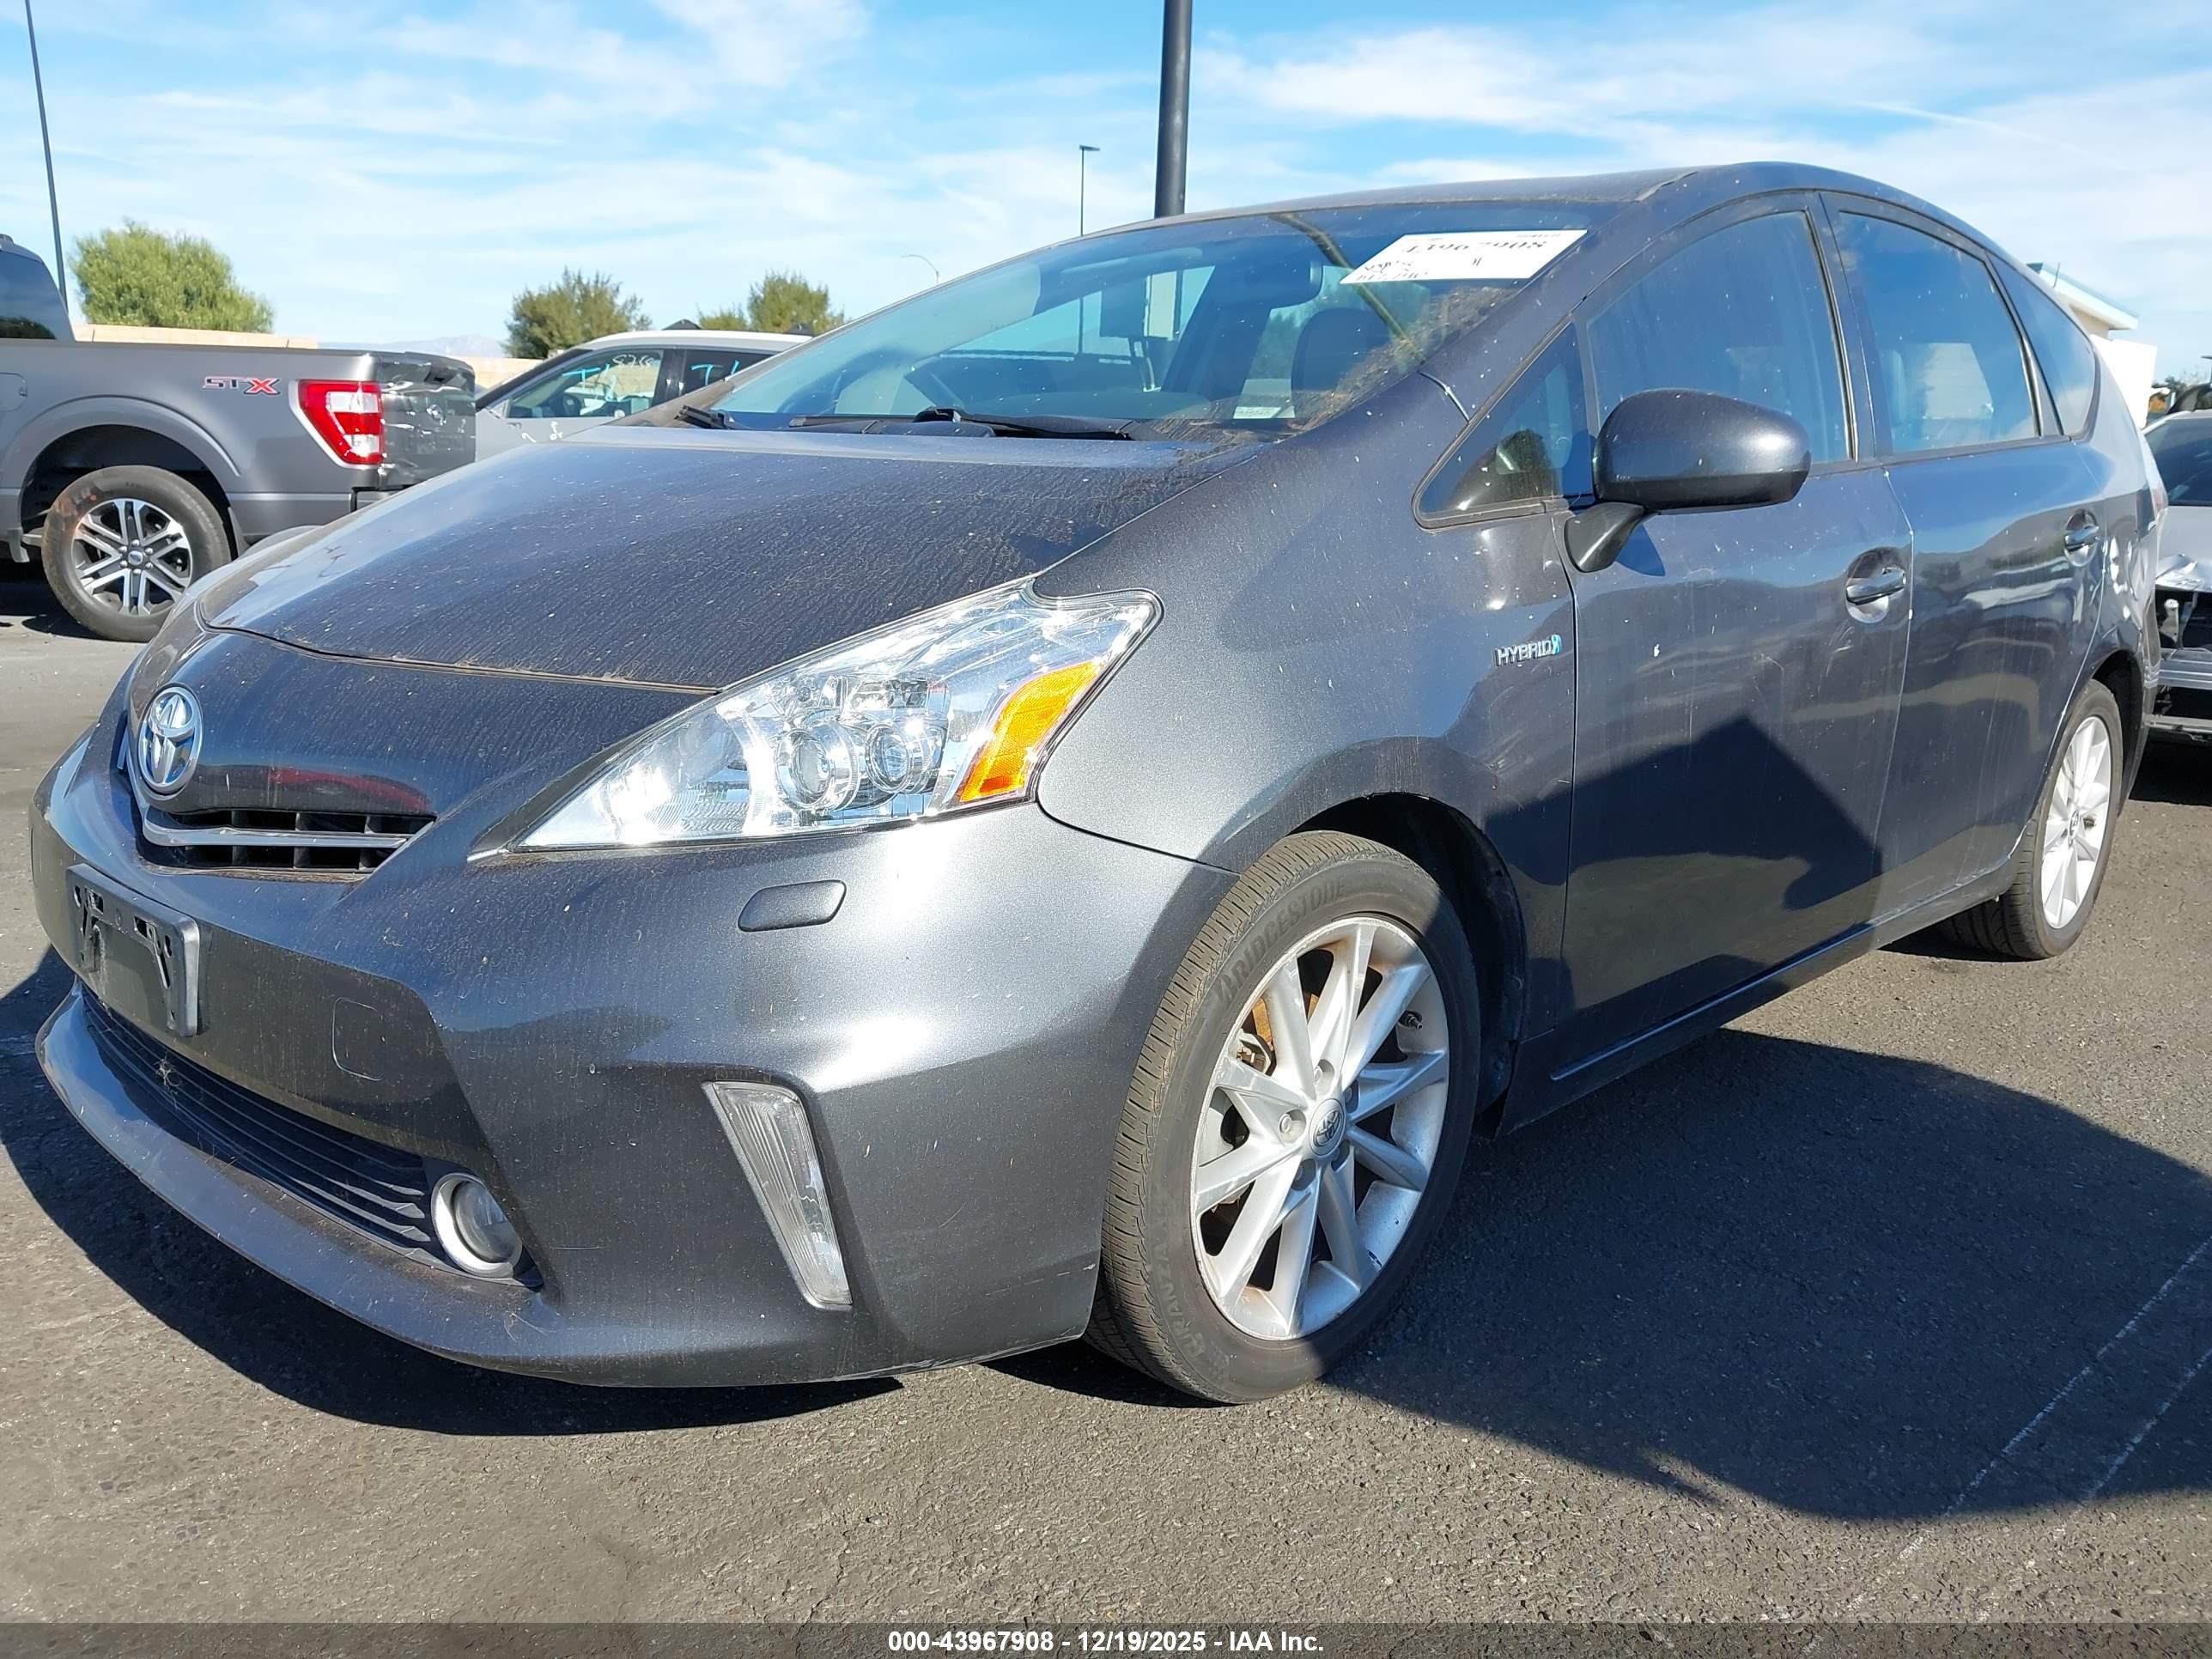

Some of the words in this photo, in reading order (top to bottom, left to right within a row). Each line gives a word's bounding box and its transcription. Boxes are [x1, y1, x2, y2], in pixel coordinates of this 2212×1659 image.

[202, 376, 281, 395] STX
[1495, 640, 1553, 666] HYBRID
[1215, 878, 1346, 1004] BRIDGESTONE
